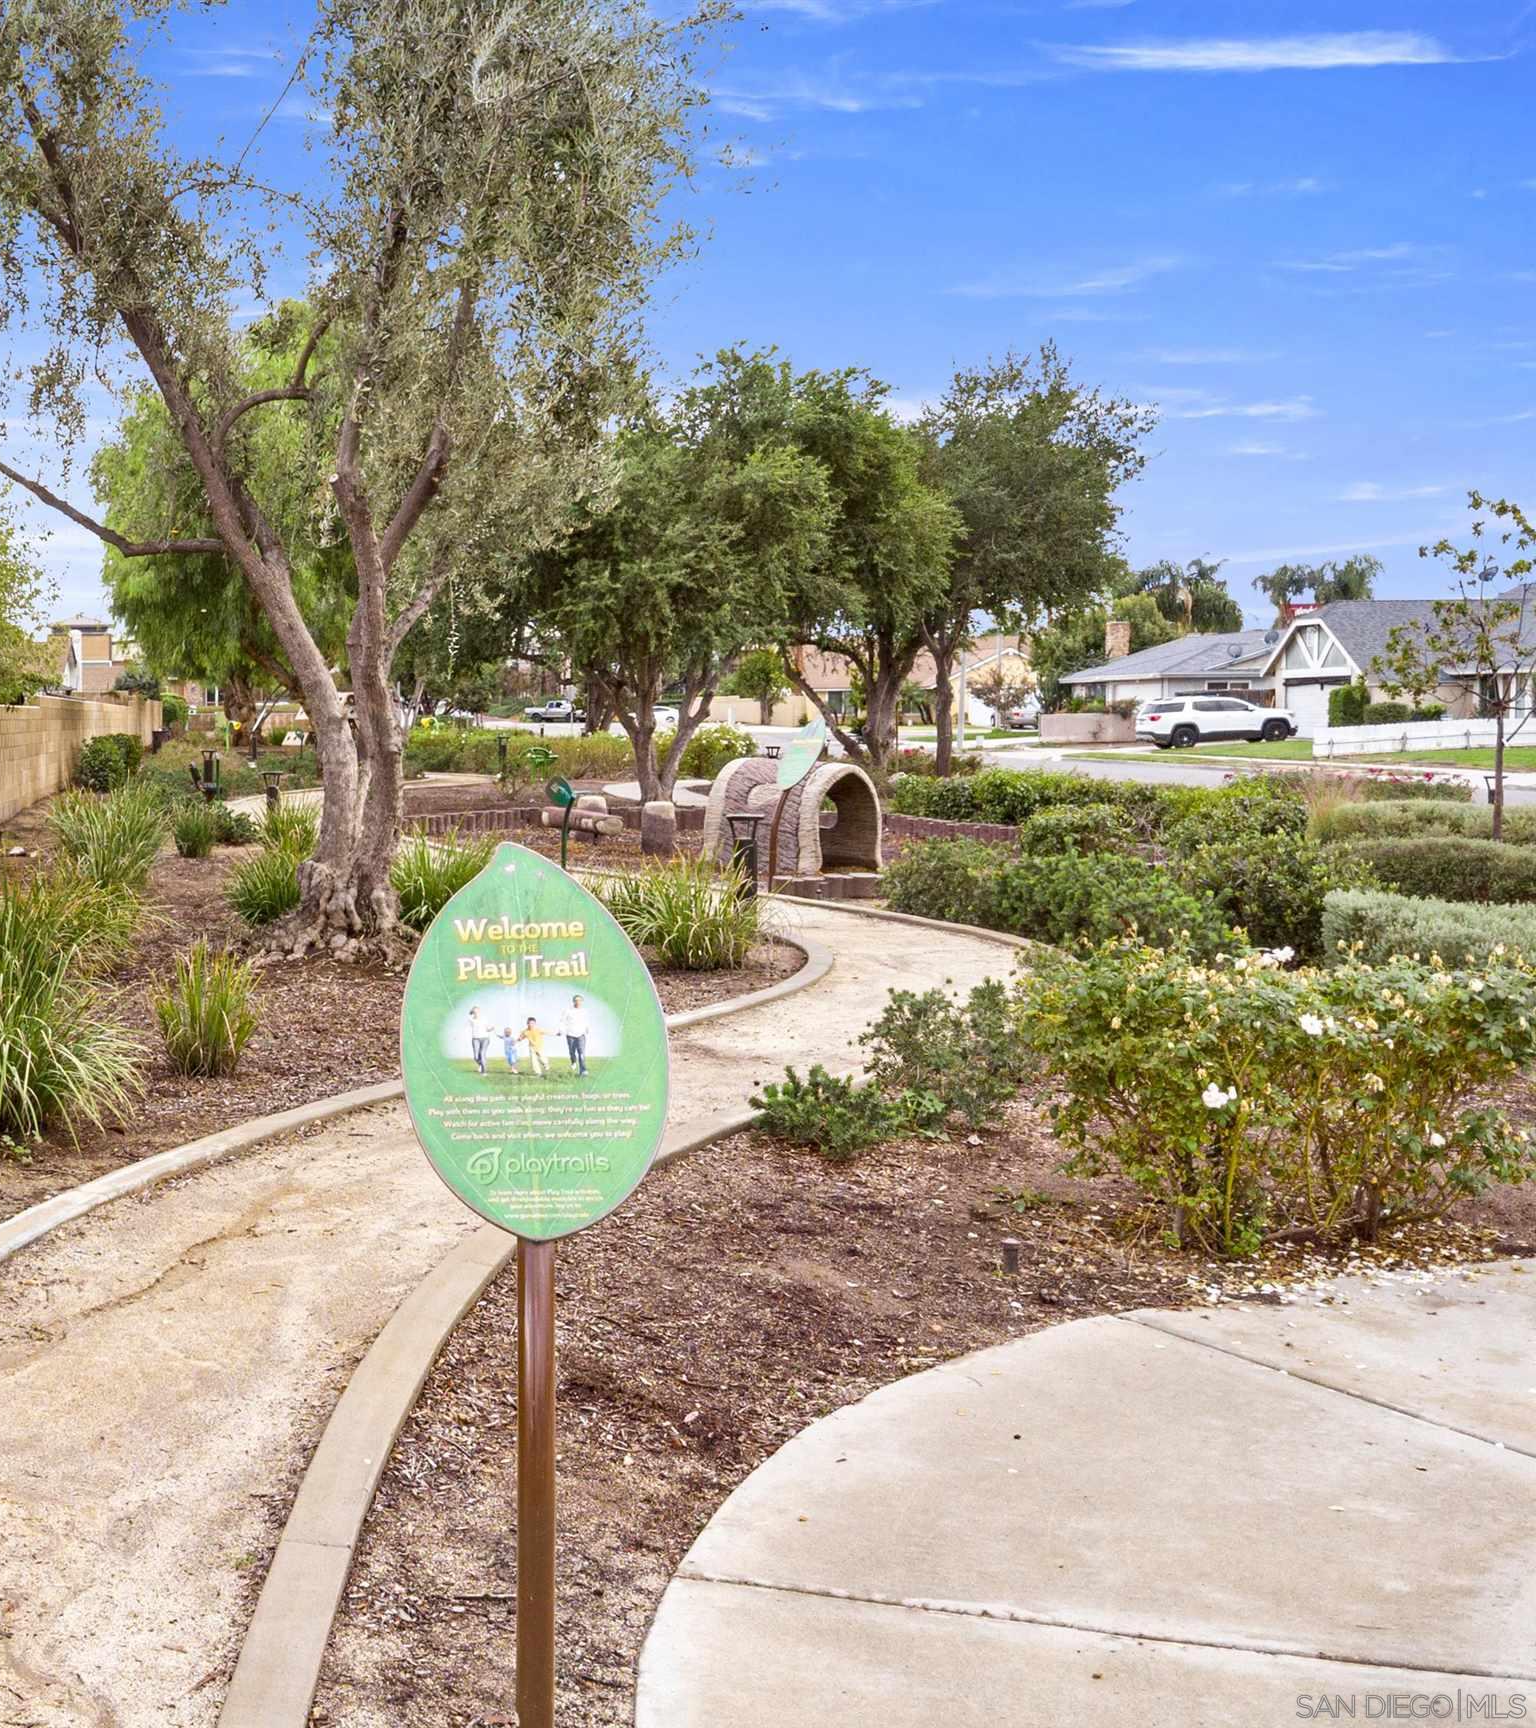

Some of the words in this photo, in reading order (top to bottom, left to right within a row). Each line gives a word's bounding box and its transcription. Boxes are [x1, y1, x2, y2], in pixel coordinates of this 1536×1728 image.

[454, 916, 585, 943] Welcome
[502, 944, 515, 954] TO
[457, 956, 517, 985] Play
[524, 951, 589, 977] Trail
[505, 1152, 611, 1179] playtrails
